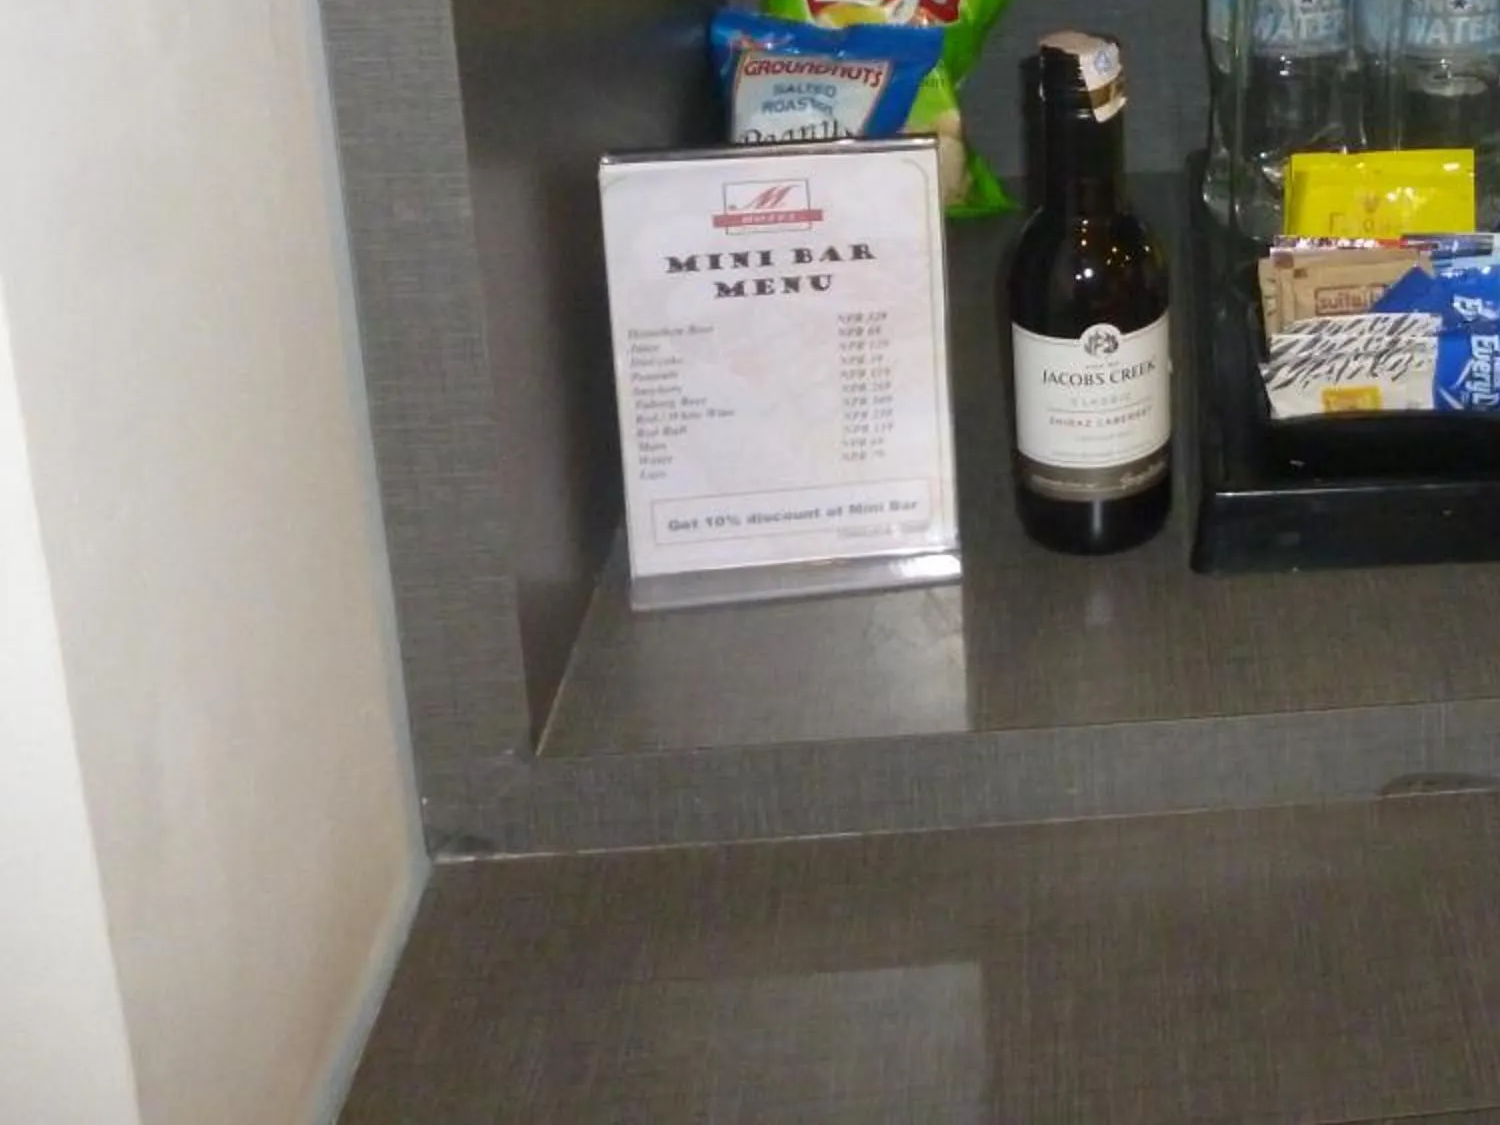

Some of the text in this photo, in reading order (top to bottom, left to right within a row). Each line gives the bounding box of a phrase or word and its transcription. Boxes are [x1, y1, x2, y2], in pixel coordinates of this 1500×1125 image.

[1407, 14, 1500, 45] WATER
[665, 243, 877, 274] MINI BAR
[713, 274, 834, 299] MENU
[1109, 361, 1157, 385] CREEK
[1467, 334, 1500, 407] EveryD
[668, 500, 920, 533] Get 10% discount at Mini Bar
